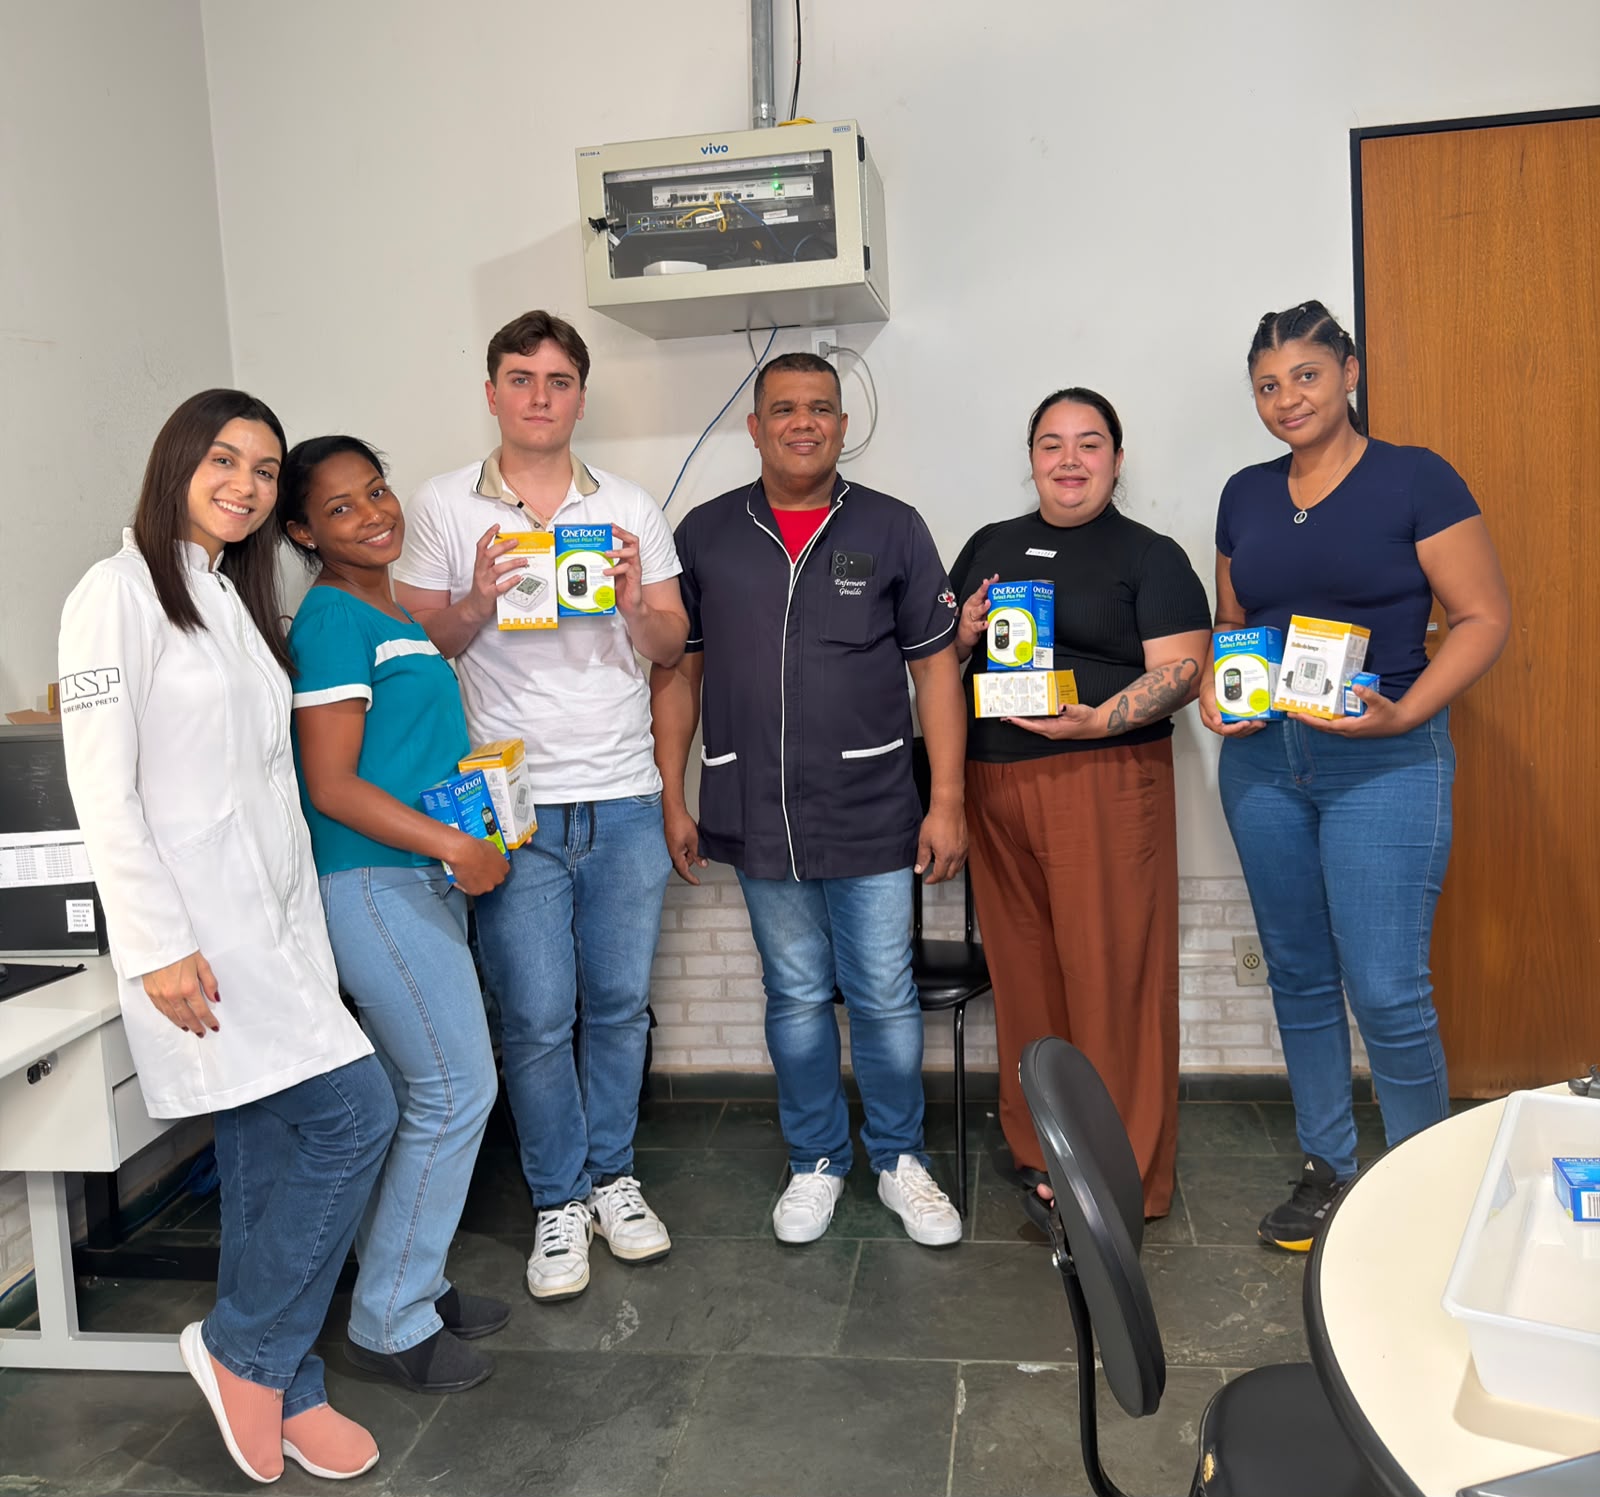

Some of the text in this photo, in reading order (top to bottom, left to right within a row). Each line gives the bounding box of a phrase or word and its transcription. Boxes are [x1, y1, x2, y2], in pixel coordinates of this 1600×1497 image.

[701, 143, 728, 154] vivo
[562, 529, 605, 537] ONETOUCH
[992, 586, 1027, 595] ONETOUCH
[1219, 632, 1259, 643] ONETOUCH
[95, 697, 118, 706] PRETO
